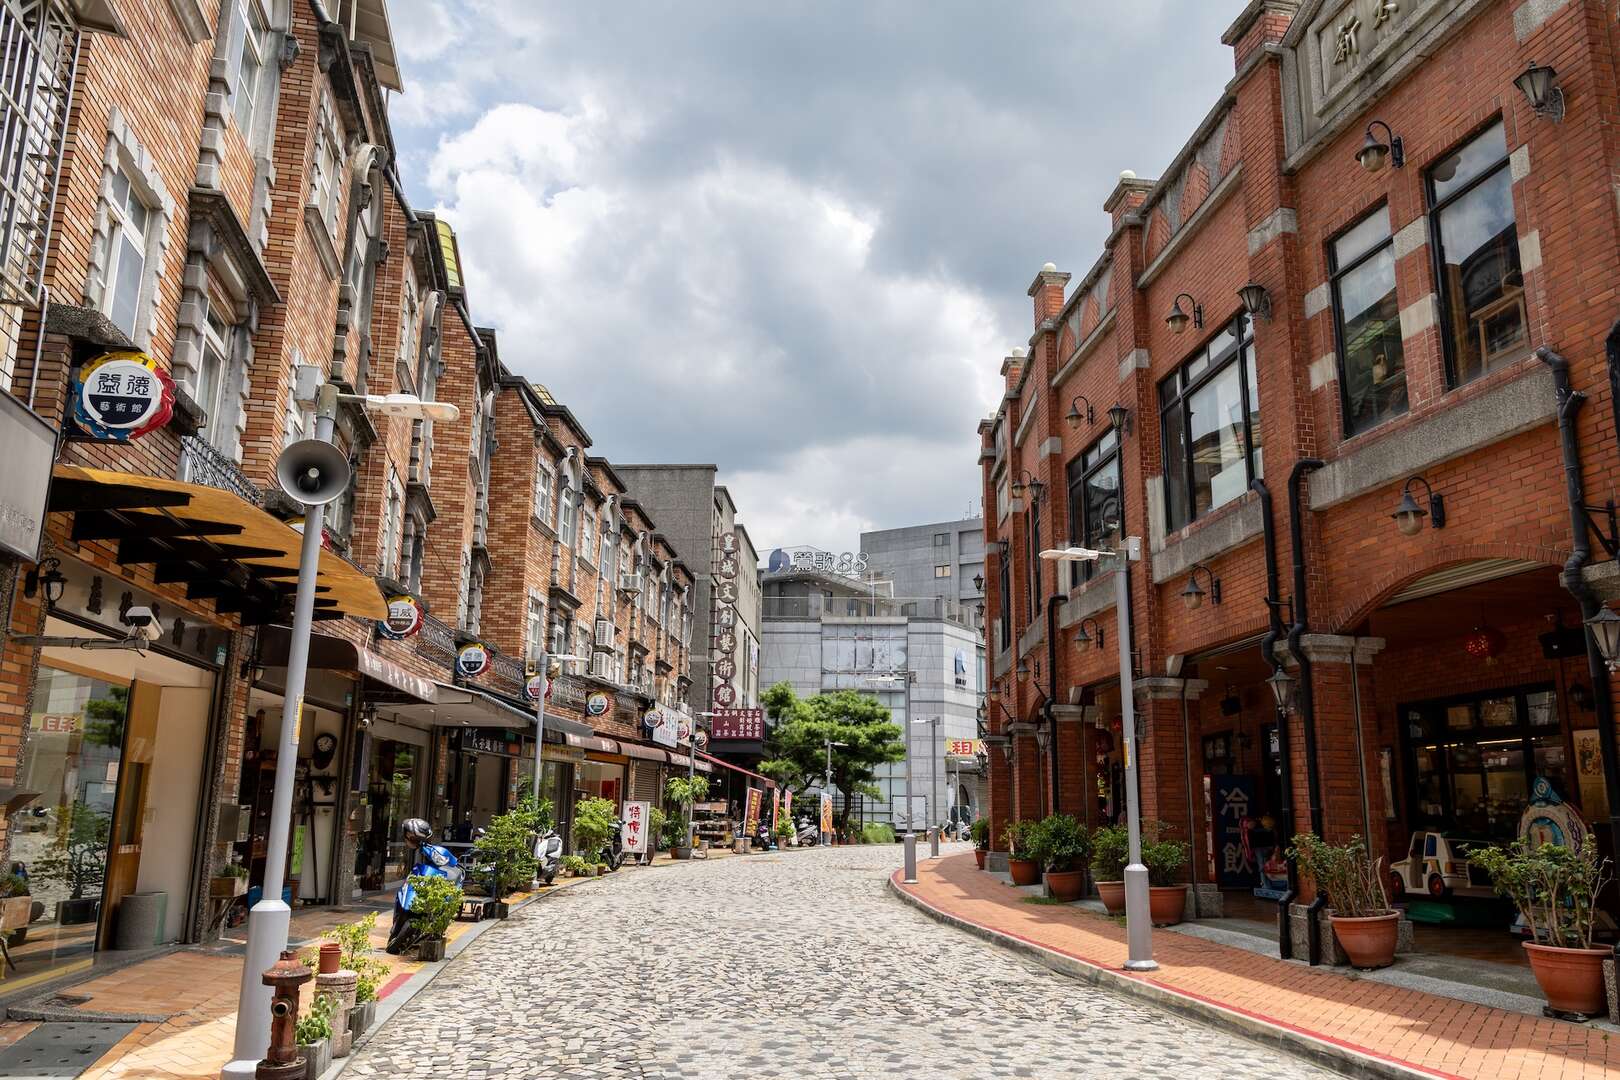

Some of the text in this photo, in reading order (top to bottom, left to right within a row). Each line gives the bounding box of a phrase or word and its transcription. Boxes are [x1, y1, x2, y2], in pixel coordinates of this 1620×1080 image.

[100, 401, 143, 413] 藝術館
[717, 535, 736, 703] 皇城文創藝術館
[952, 741, 974, 755] 租
[627, 805, 641, 849] 特價中
